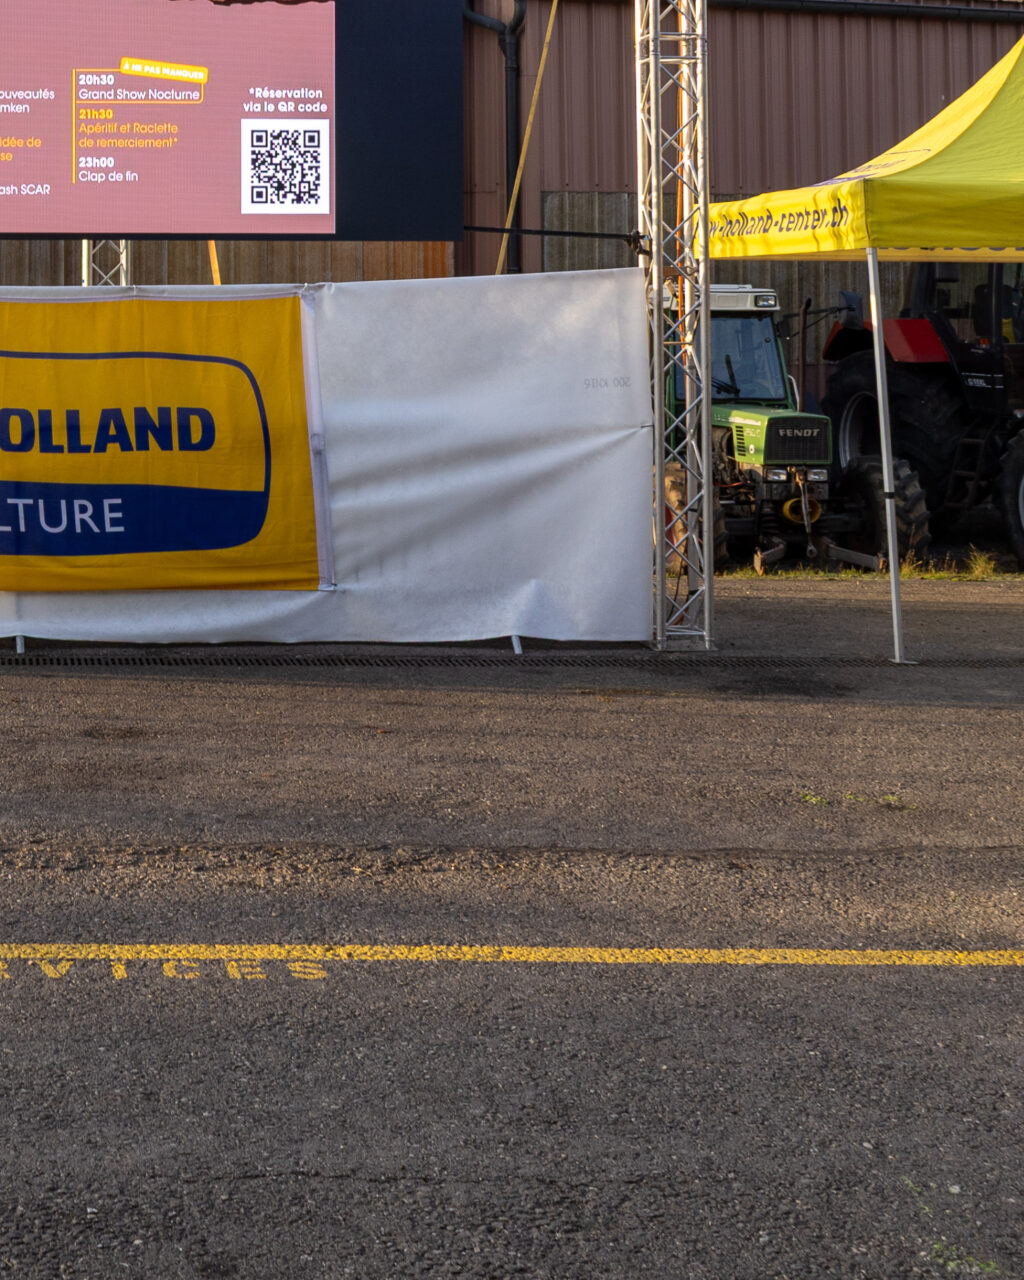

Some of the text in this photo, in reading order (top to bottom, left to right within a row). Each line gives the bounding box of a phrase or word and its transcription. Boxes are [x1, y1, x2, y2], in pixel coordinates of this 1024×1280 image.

[79, 74, 115, 85] 20h30
[79, 88, 200, 99] Grand Show Nocturne
[243, 102, 328, 113] via le QR code
[79, 109, 113, 119] 21h30
[79, 123, 178, 135] Apéritif et Raclette
[26, 136, 42, 147] de
[79, 137, 93, 148] de
[79, 157, 115, 168] 23h00
[79, 171, 138, 183] Clap de fin
[20, 184, 51, 195] SCAR
[707, 198, 849, 238] w-holland-center.ch
[779, 428, 820, 438] FENDT
